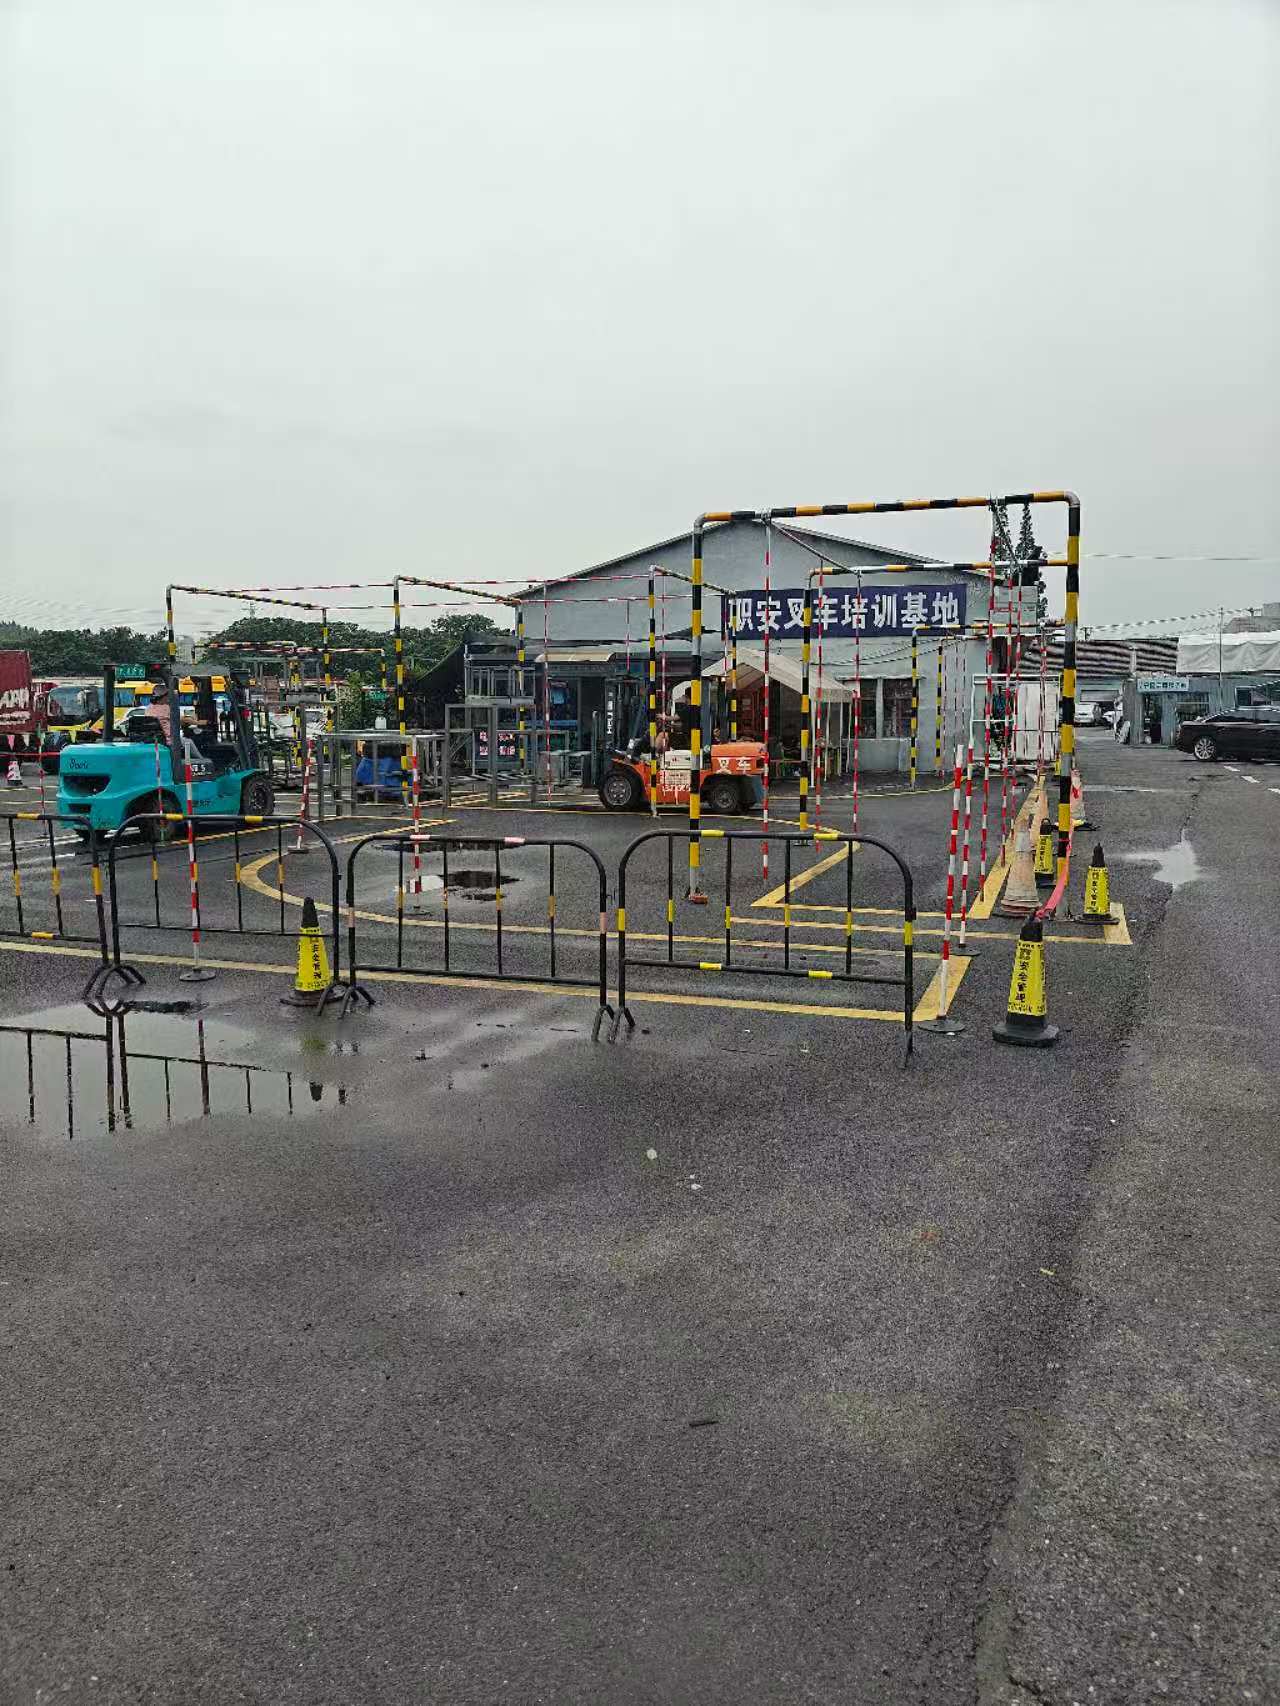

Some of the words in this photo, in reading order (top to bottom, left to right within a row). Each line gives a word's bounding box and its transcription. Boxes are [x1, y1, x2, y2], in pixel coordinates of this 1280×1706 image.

[727, 591, 960, 632] 职安叉车培训基地
